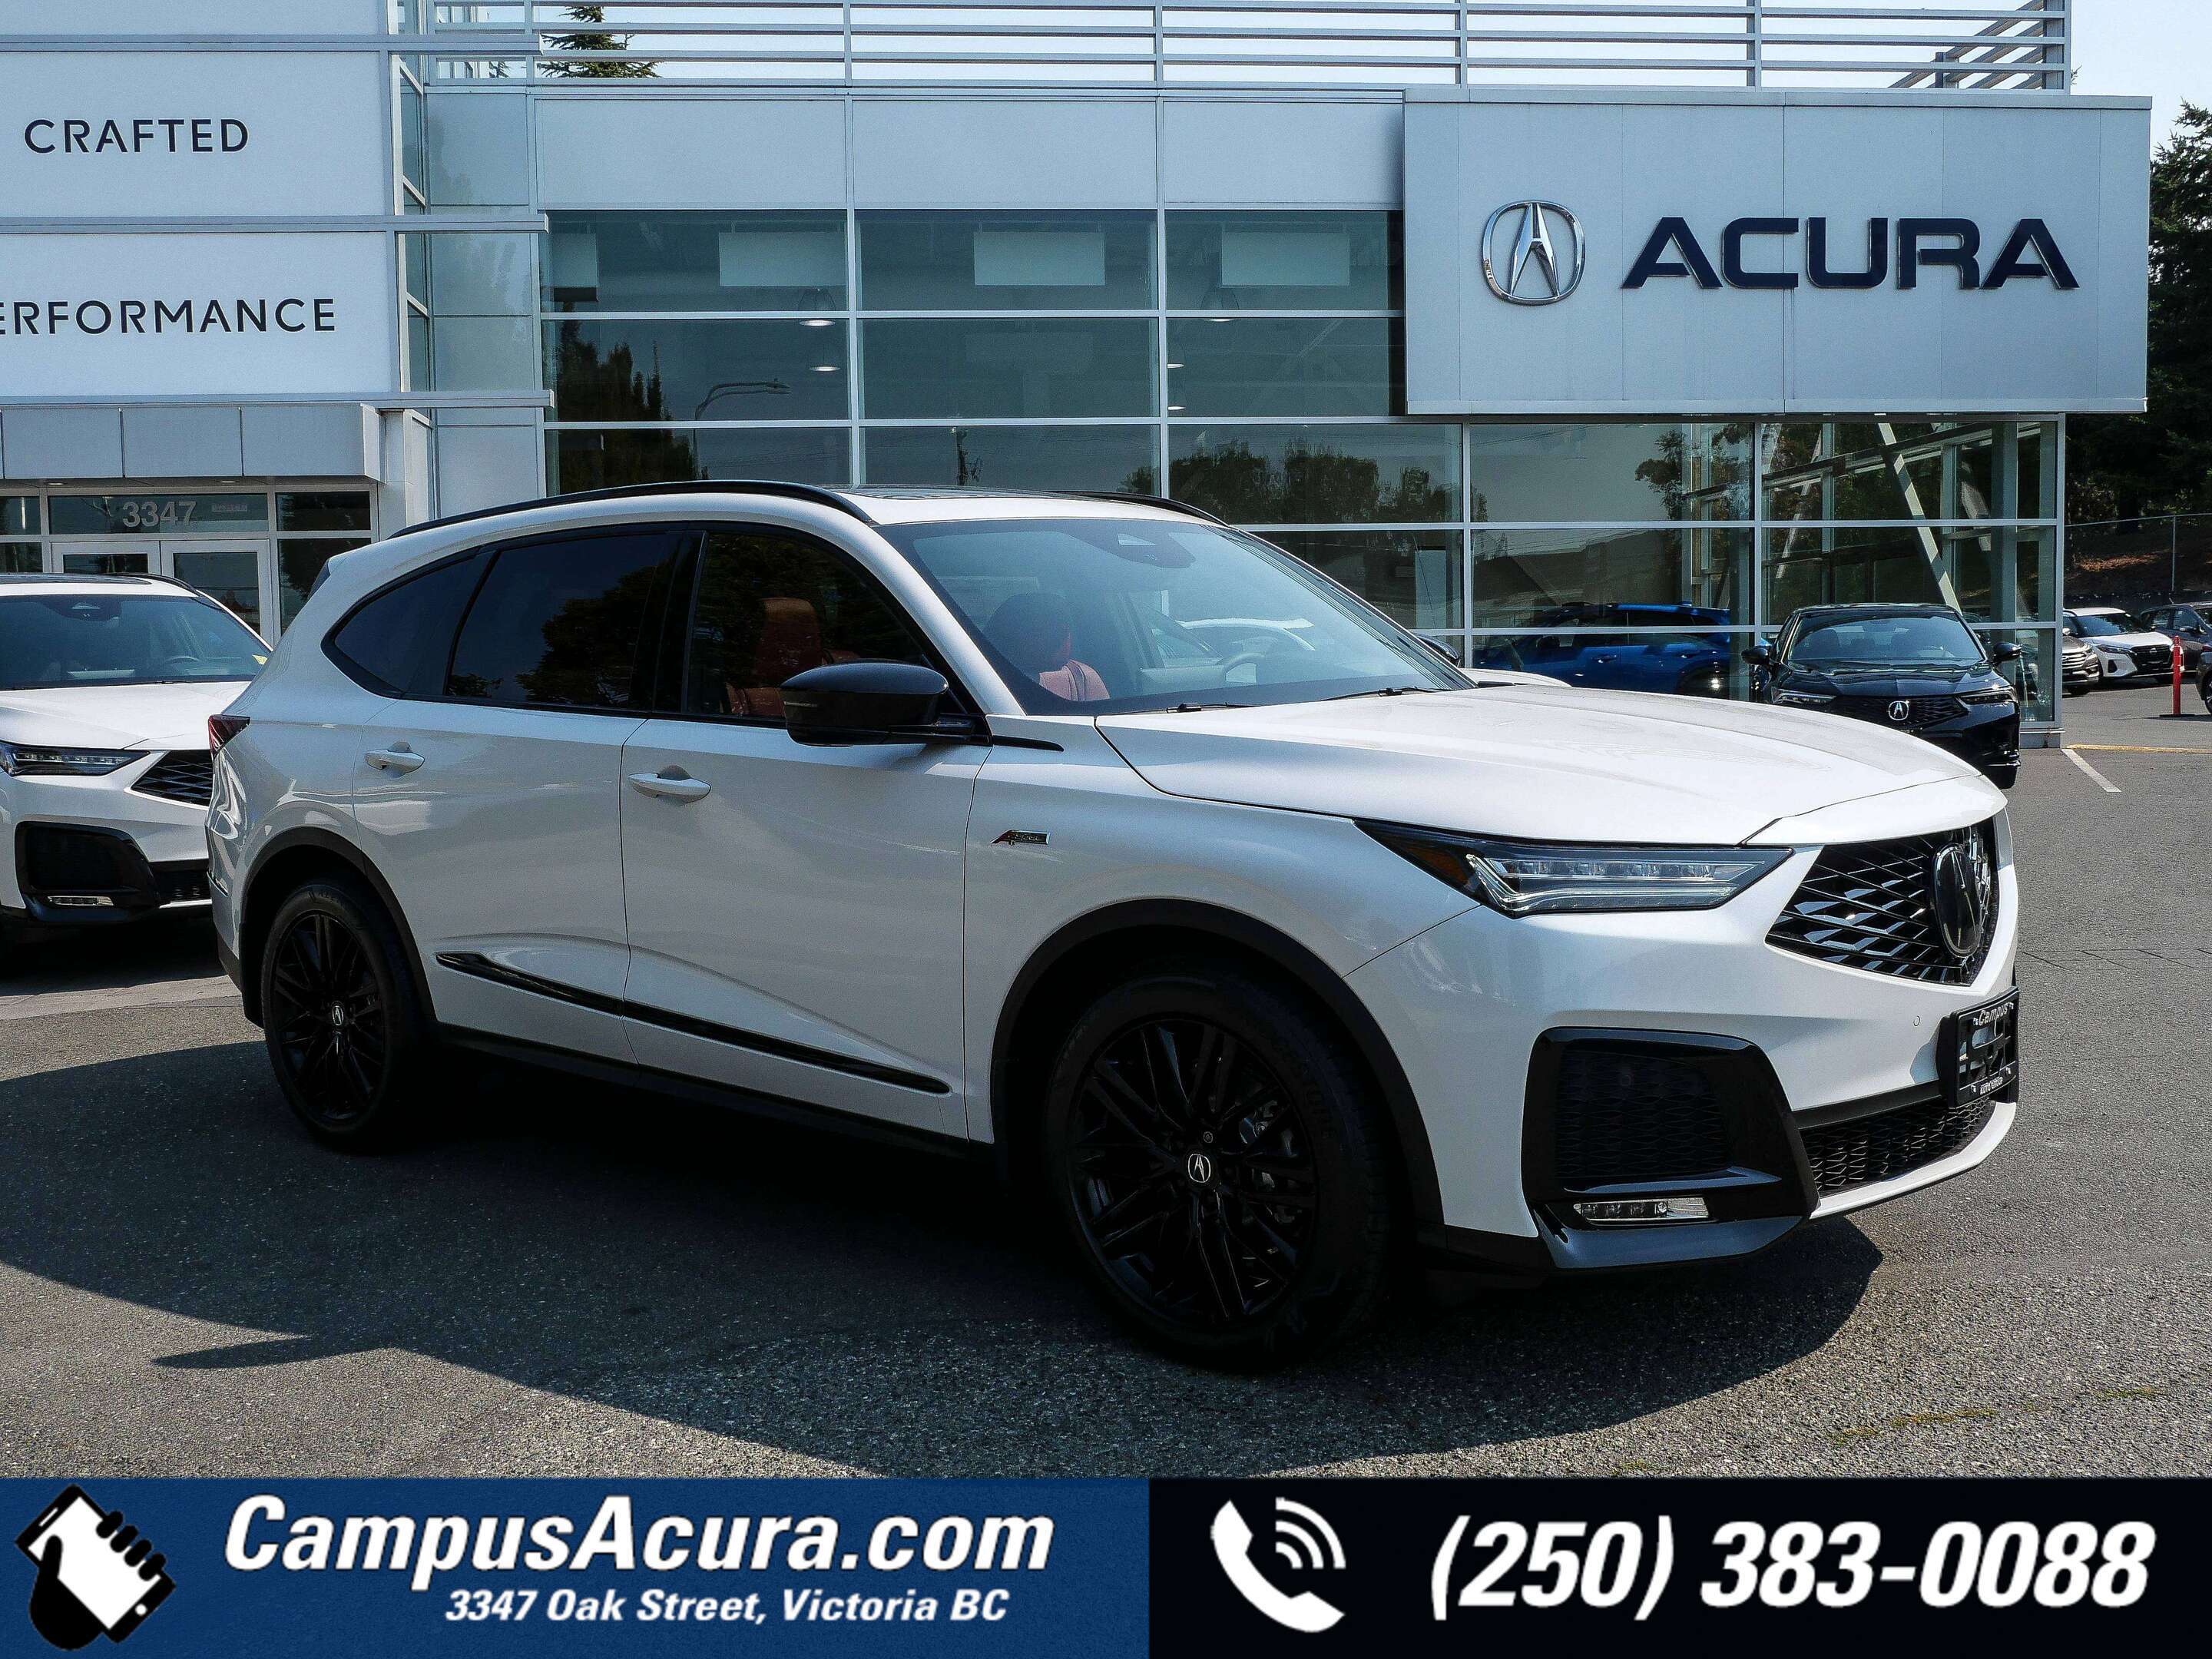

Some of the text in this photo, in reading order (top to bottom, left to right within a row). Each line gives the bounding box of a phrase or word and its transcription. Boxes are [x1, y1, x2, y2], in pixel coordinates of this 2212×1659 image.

[24, 118, 248, 154] CRAFTED
[1620, 217, 2080, 293] ACURA
[0, 297, 336, 335] RFORMANCE
[122, 501, 197, 528] 3347
[1979, 1004, 2008, 1027] Campus
